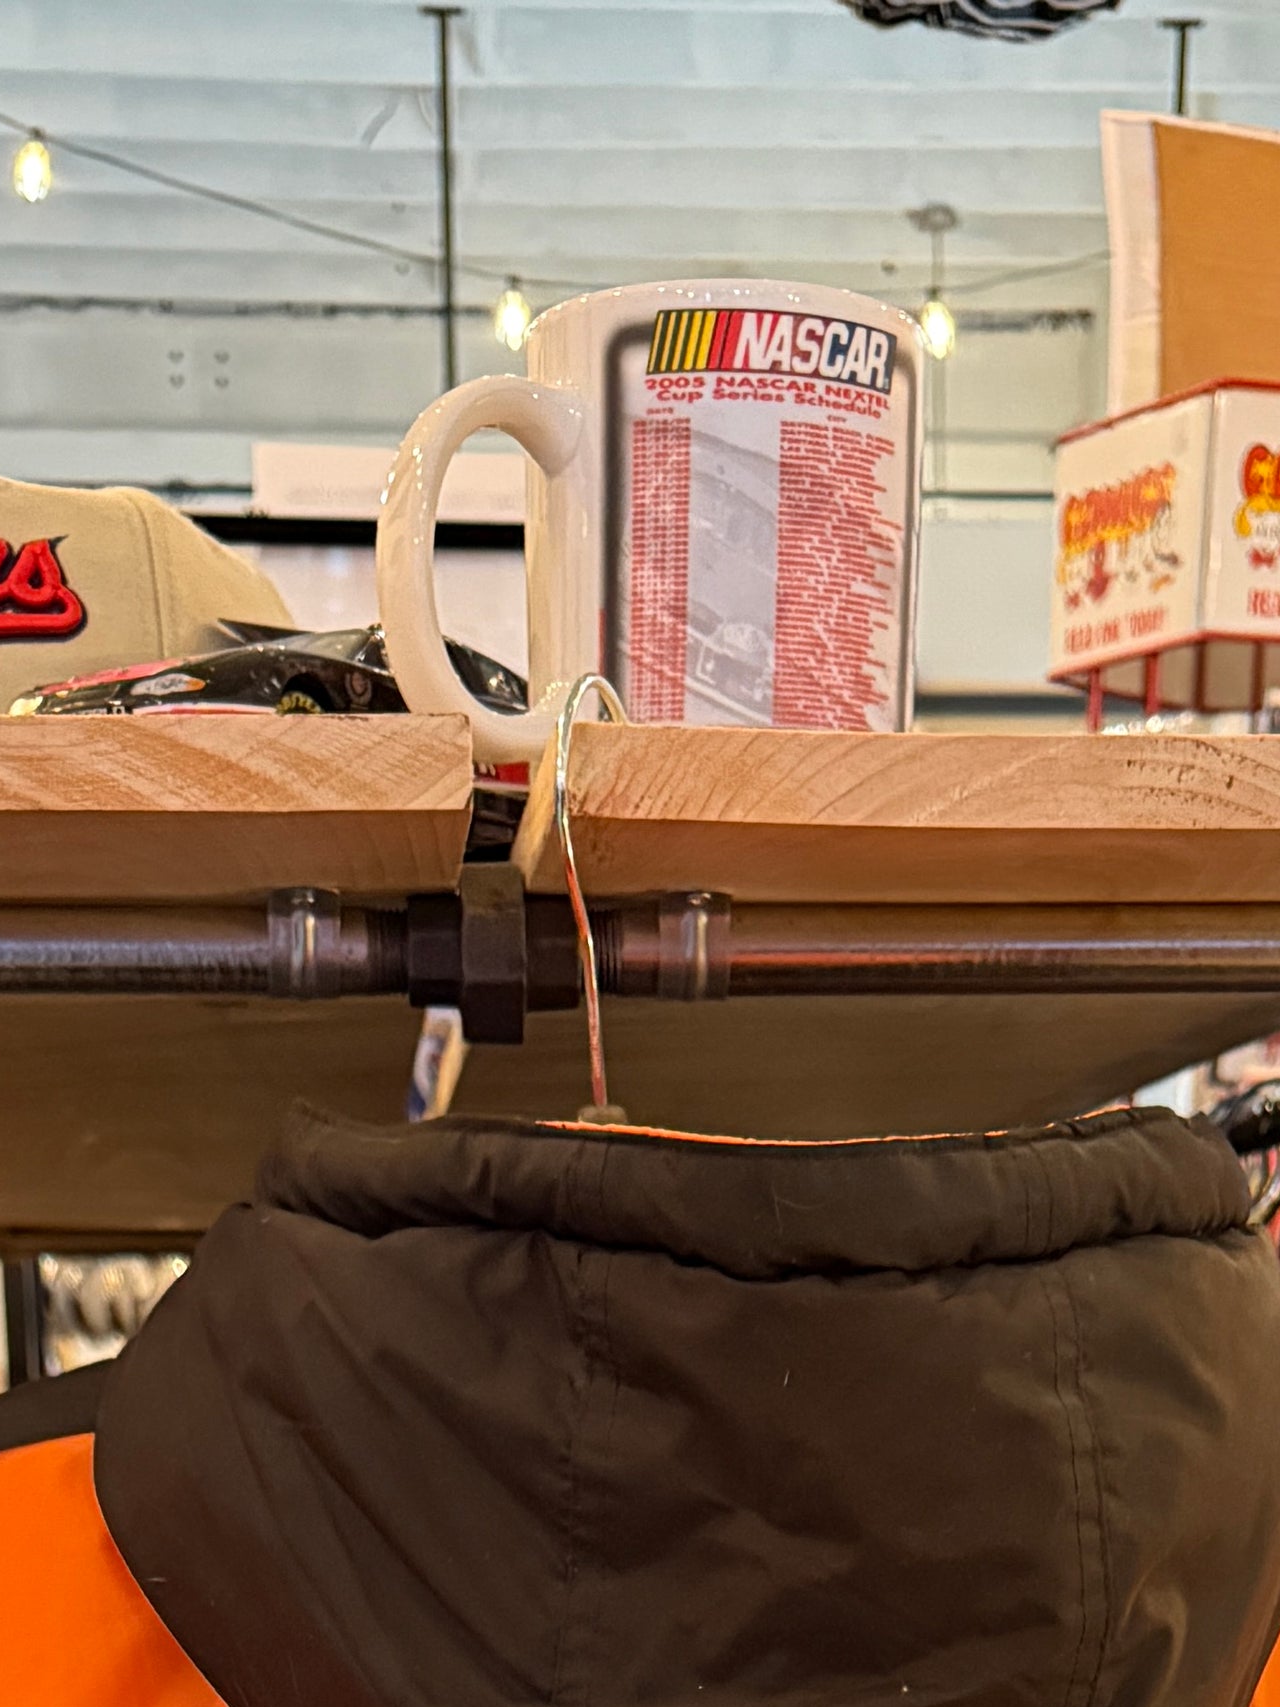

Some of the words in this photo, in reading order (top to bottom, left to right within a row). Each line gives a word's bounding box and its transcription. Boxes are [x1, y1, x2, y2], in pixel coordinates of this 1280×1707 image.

[733, 311, 889, 390] NASCAR
[644, 376, 706, 391] 2005
[715, 375, 817, 394] NASCAR
[824, 385, 891, 411] NEXTEL
[656, 389, 704, 404] Cup
[712, 388, 785, 404] Series
[794, 393, 882, 420] Schedule
